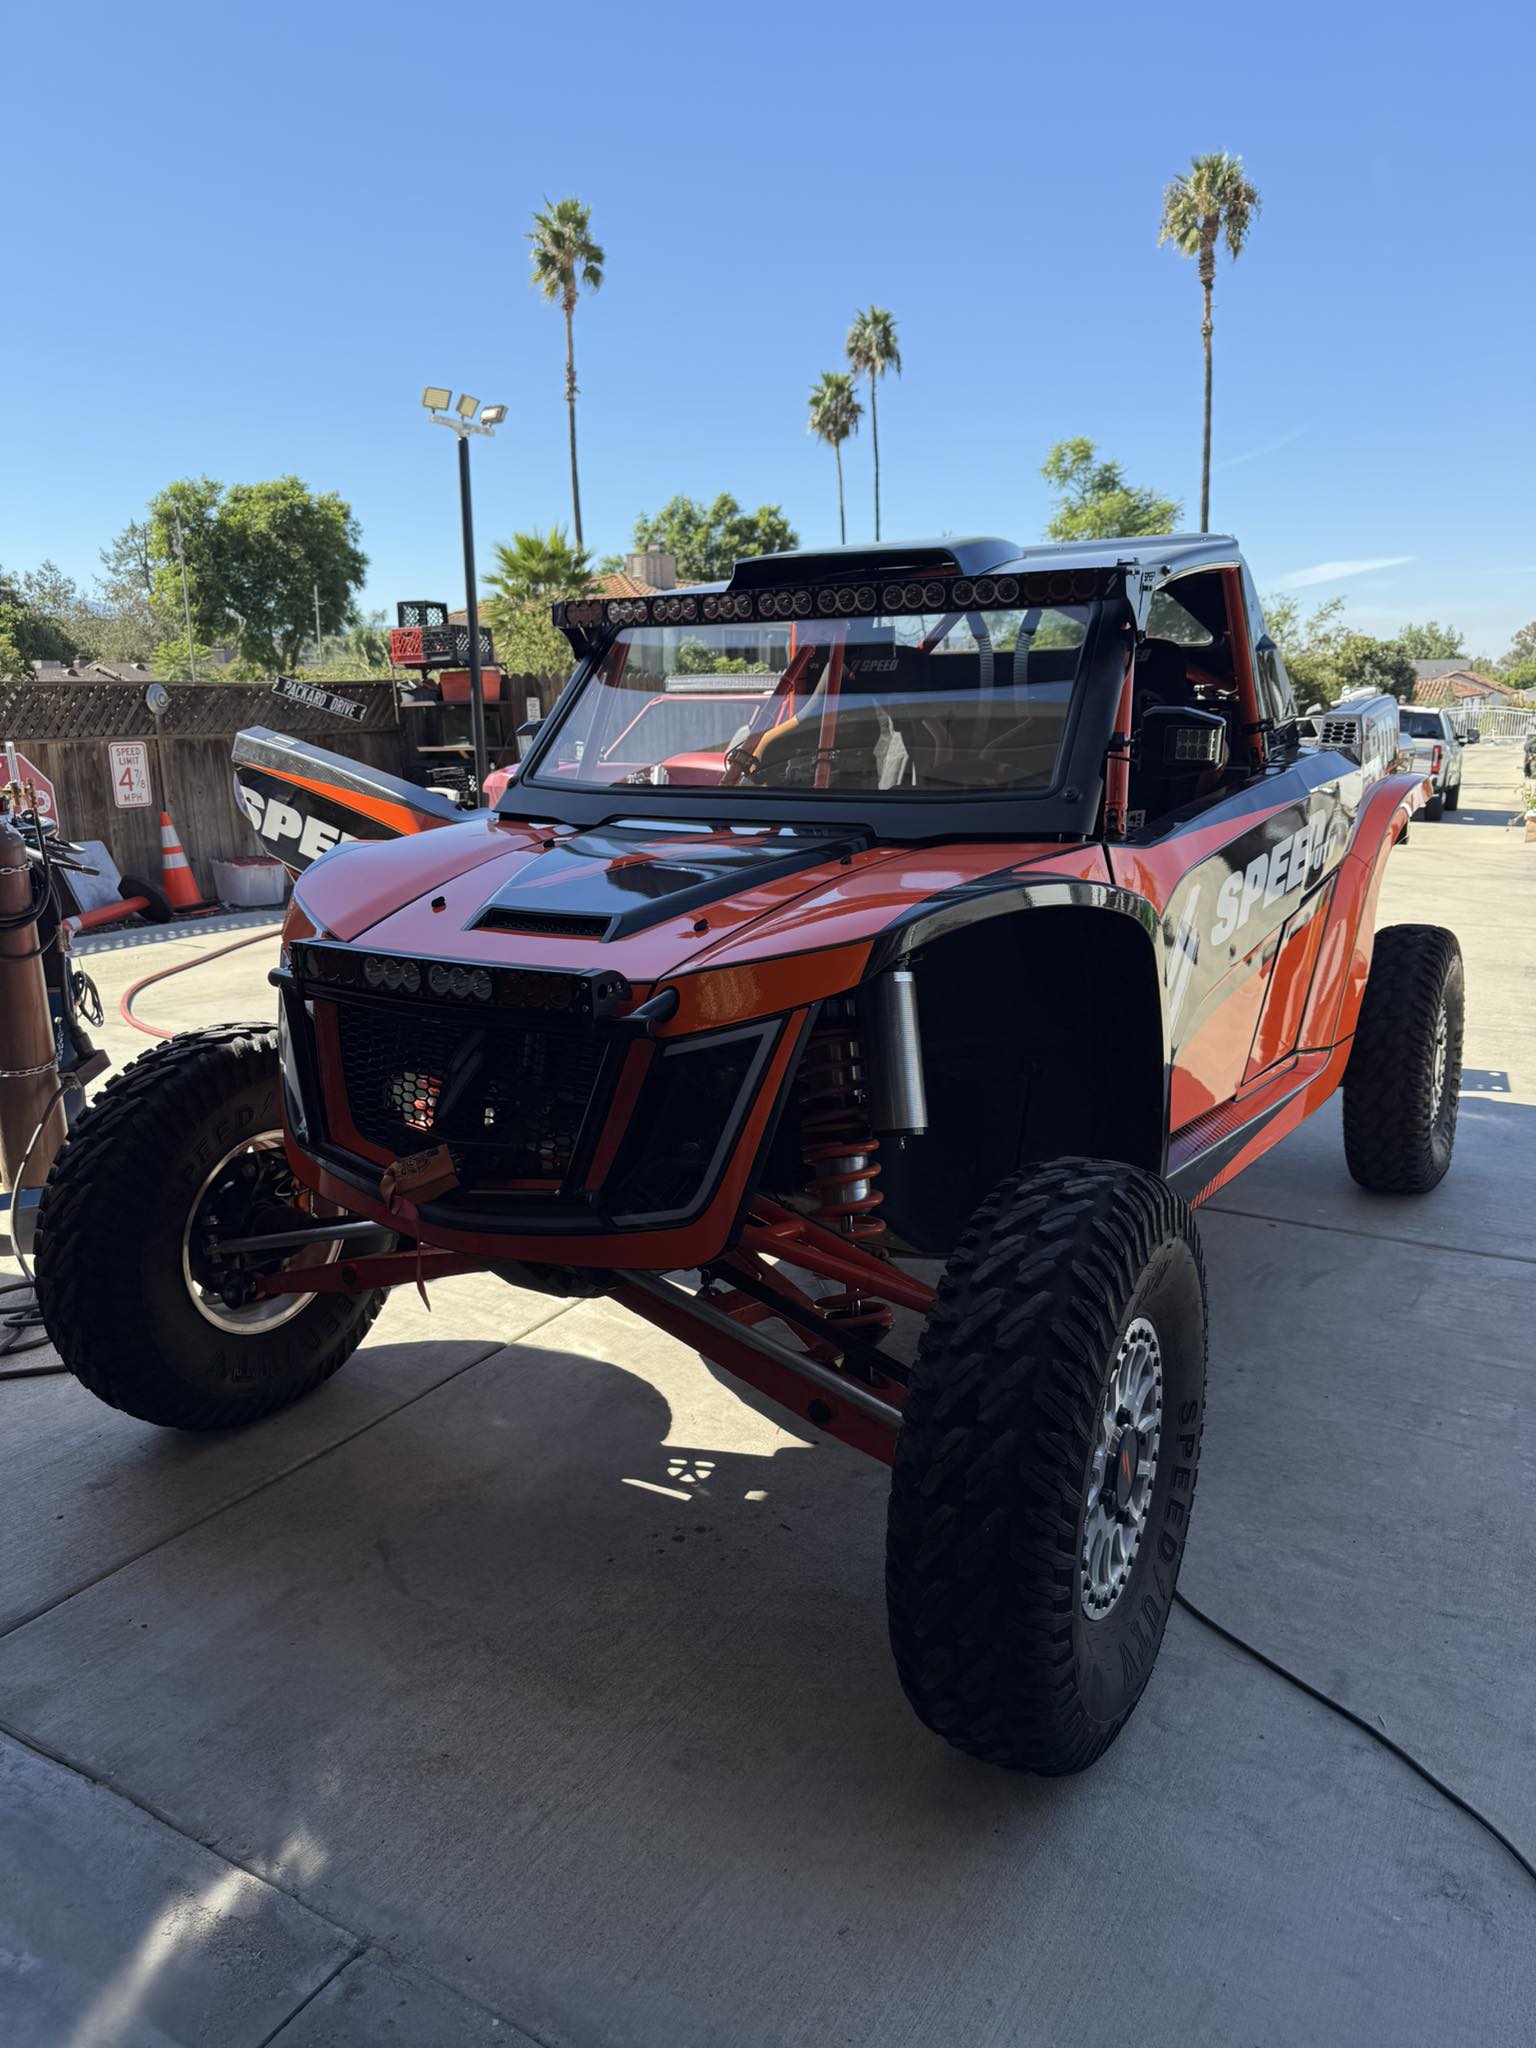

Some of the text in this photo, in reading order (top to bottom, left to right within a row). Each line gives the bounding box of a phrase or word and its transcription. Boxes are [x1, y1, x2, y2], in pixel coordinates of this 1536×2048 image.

[860, 659, 898, 672] SPEED
[283, 681, 358, 717] PACKARD DRIVE
[116, 747, 141, 756] SPEED
[119, 756, 139, 765] LIMIT
[124, 793, 143, 802] MPH
[239, 784, 360, 861] SPE
[1210, 808, 1328, 946] SPEED
[1155, 1399, 1199, 1563] SPEED
